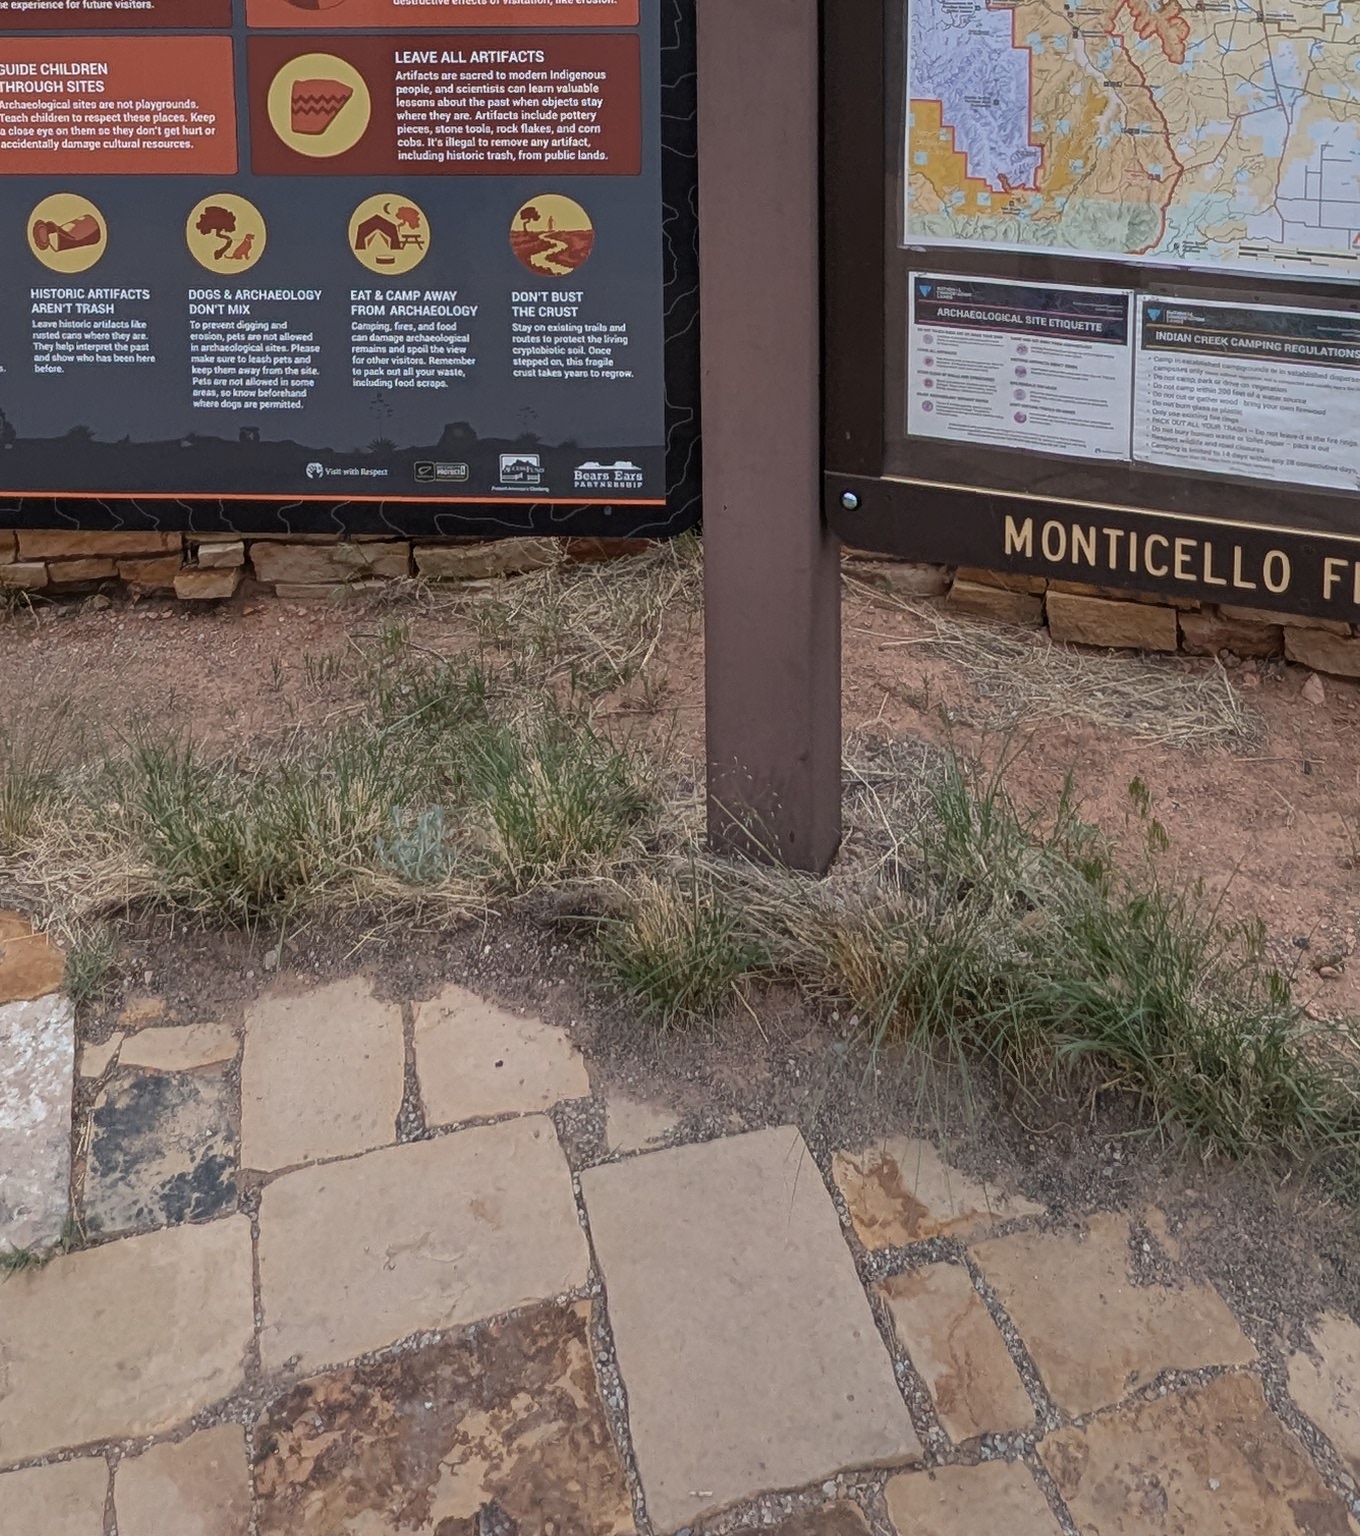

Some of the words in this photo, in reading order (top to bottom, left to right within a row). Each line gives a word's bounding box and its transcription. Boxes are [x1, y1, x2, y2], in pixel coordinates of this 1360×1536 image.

[395, 50, 438, 63] LEAVE
[440, 50, 467, 63] ALL
[469, 50, 544, 63] ARTIFACTS
[39, 62, 108, 75] CHILDREN
[395, 69, 439, 81] Artifacts
[440, 72, 457, 80] are
[459, 69, 493, 80] sacred
[495, 70, 506, 80] to
[508, 69, 548, 80] modern
[549, 68, 606, 82] Indigenous
[66, 80, 105, 92] SITES
[72, 98, 97, 109] sites
[98, 101, 115, 109] are
[116, 100, 134, 109] not
[135, 98, 199, 111] playgrounds.
[30, 288, 85, 299] HISTORIC
[87, 288, 150, 300] ARTIFACTS
[188, 289, 221, 300] DOGS
[223, 289, 232, 300] &
[234, 288, 322, 301] ARCHAEOLOGY
[350, 289, 372, 301] EAT
[374, 289, 383, 301] &
[385, 289, 421, 301] CAMP
[423, 290, 457, 301] AWAY
[511, 291, 549, 302] DON'T
[551, 291, 584, 302] BUST
[31, 302, 72, 313] AREN'T
[74, 302, 114, 314] TRASH
[189, 303, 225, 314] DON'T
[227, 303, 250, 315] MIX
[350, 304, 385, 315] FROM
[389, 305, 478, 316] ARCHAEOLOGY
[511, 306, 535, 317] THE
[538, 305, 578, 317] CRUST
[936, 306, 1023, 324] ARCHAEOLOGICAL
[1024, 315, 1047, 326] SITE
[1048, 317, 1102, 332] ETIQUETTE
[1155, 330, 1191, 343] INDIAN
[1193, 334, 1228, 351] CREEK
[1230, 337, 1282, 351] CAMPING
[324, 467, 342, 475] Visit
[341, 467, 359, 475] with
[360, 467, 388, 477] Respect
[573, 470, 609, 481] Bears
[613, 470, 643, 482] Ears
[573, 469, 609, 483] Bears
[613, 469, 643, 483] Ears
[1004, 513, 1290, 595] MONTICELLO
